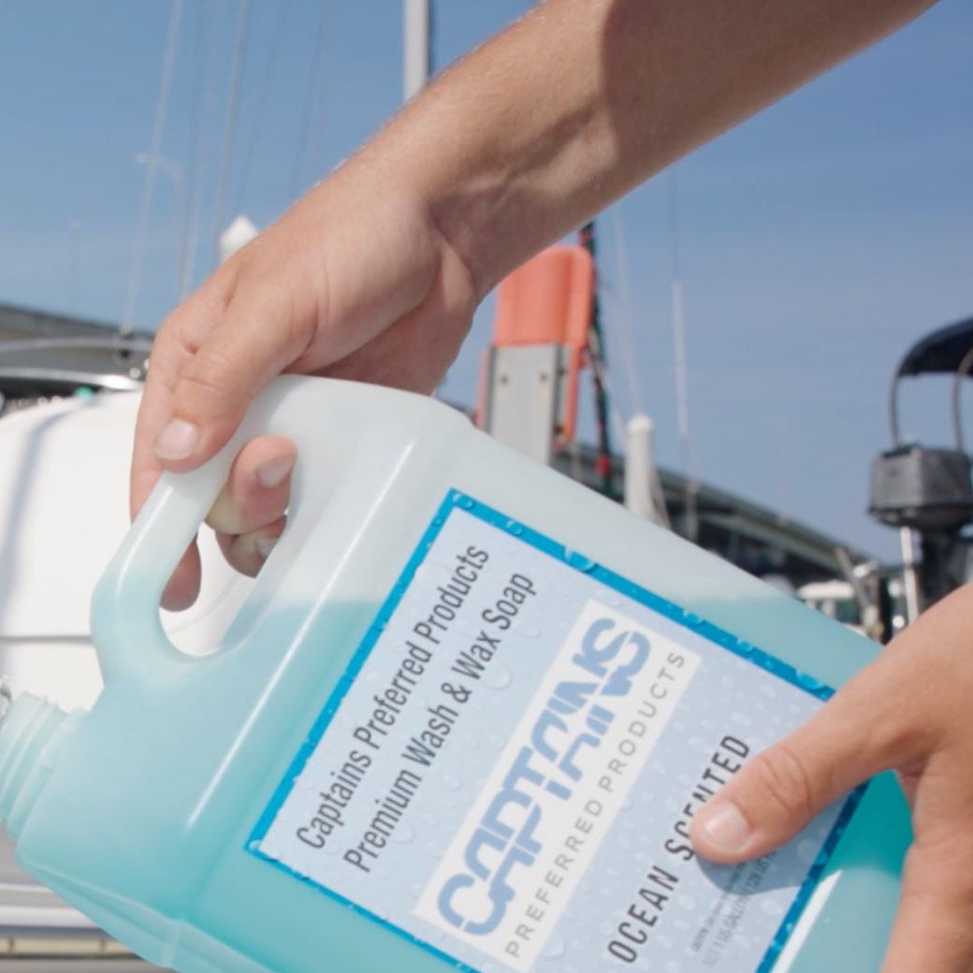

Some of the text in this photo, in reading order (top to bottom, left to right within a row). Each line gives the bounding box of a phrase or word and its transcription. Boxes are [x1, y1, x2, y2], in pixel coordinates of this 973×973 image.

[296, 546, 489, 849] Captains Preferred Products
[343, 573, 537, 873] Premium Wash & Wax Soap
[437, 617, 651, 936] CAPTAINS
[505, 652, 685, 958] PREFERRED PRODUCTS
[607, 865, 679, 963] OCEAN
